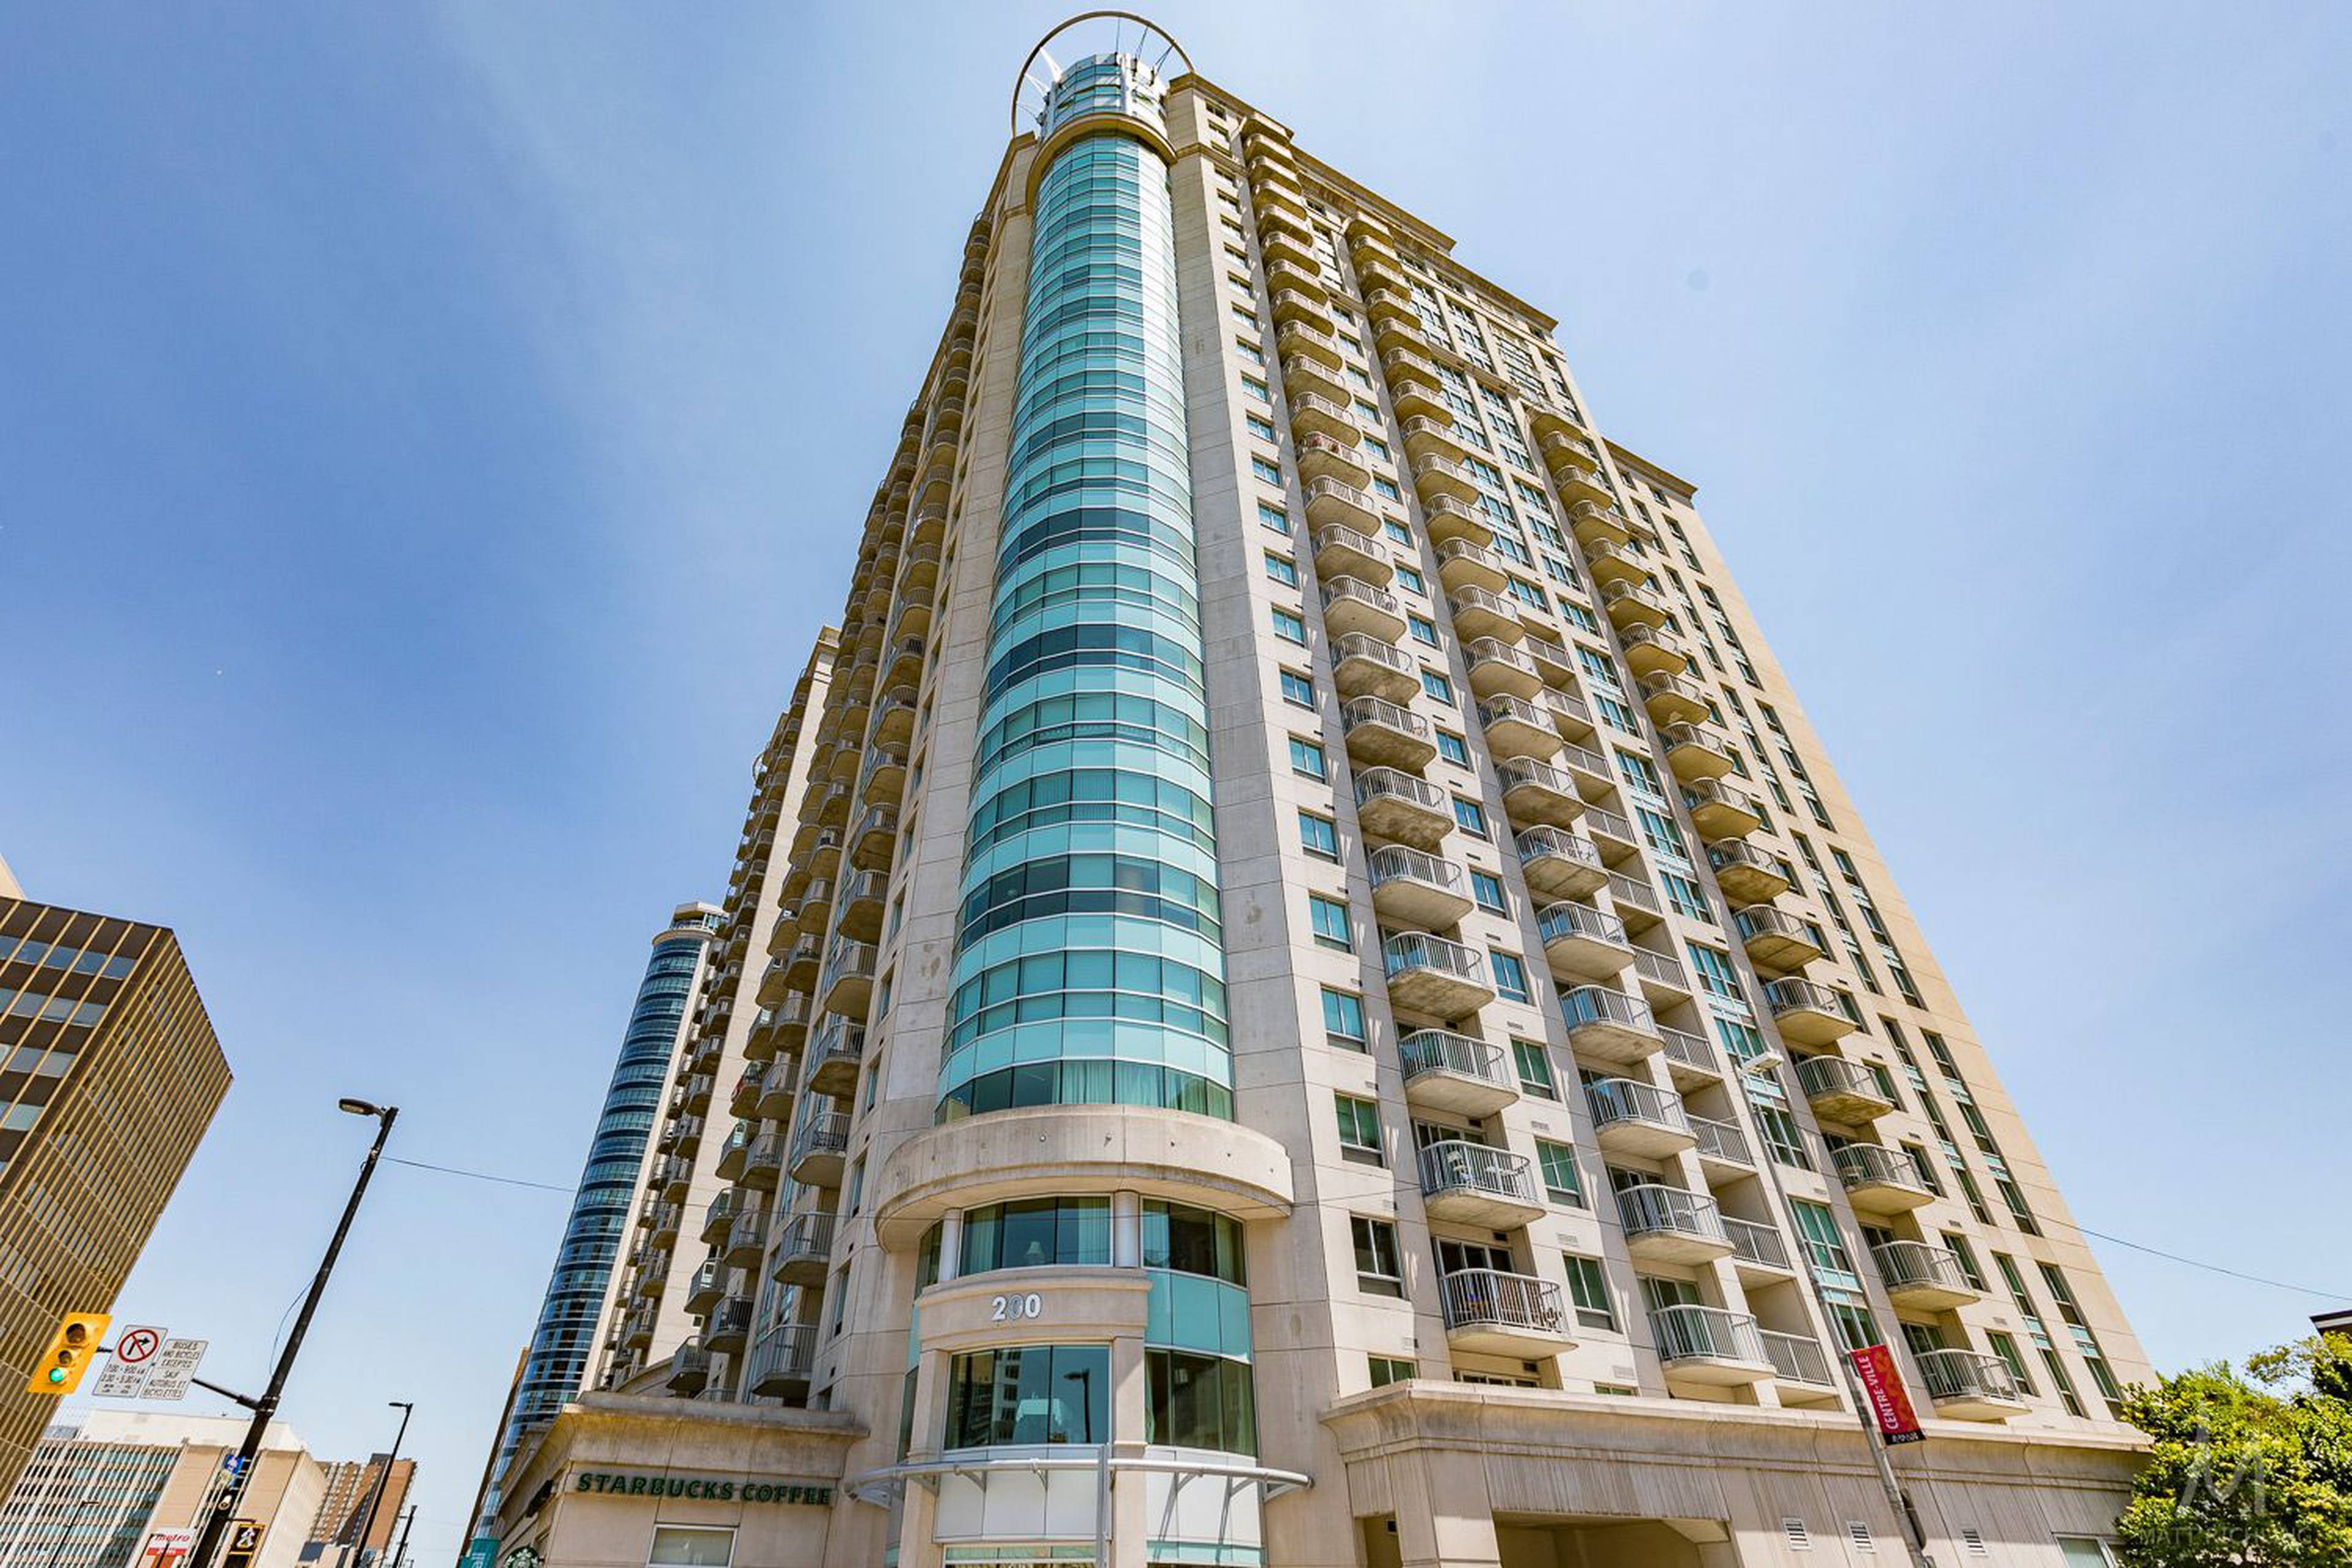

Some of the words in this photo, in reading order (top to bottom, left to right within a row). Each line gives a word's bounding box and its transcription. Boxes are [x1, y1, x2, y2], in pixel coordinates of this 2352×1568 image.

[992, 1293, 1041, 1321] 200
[1858, 1355, 1898, 1430] CENTRE-VILLE
[577, 1473, 734, 1500] STARBUCKS
[740, 1483, 832, 1506] COFFEE
